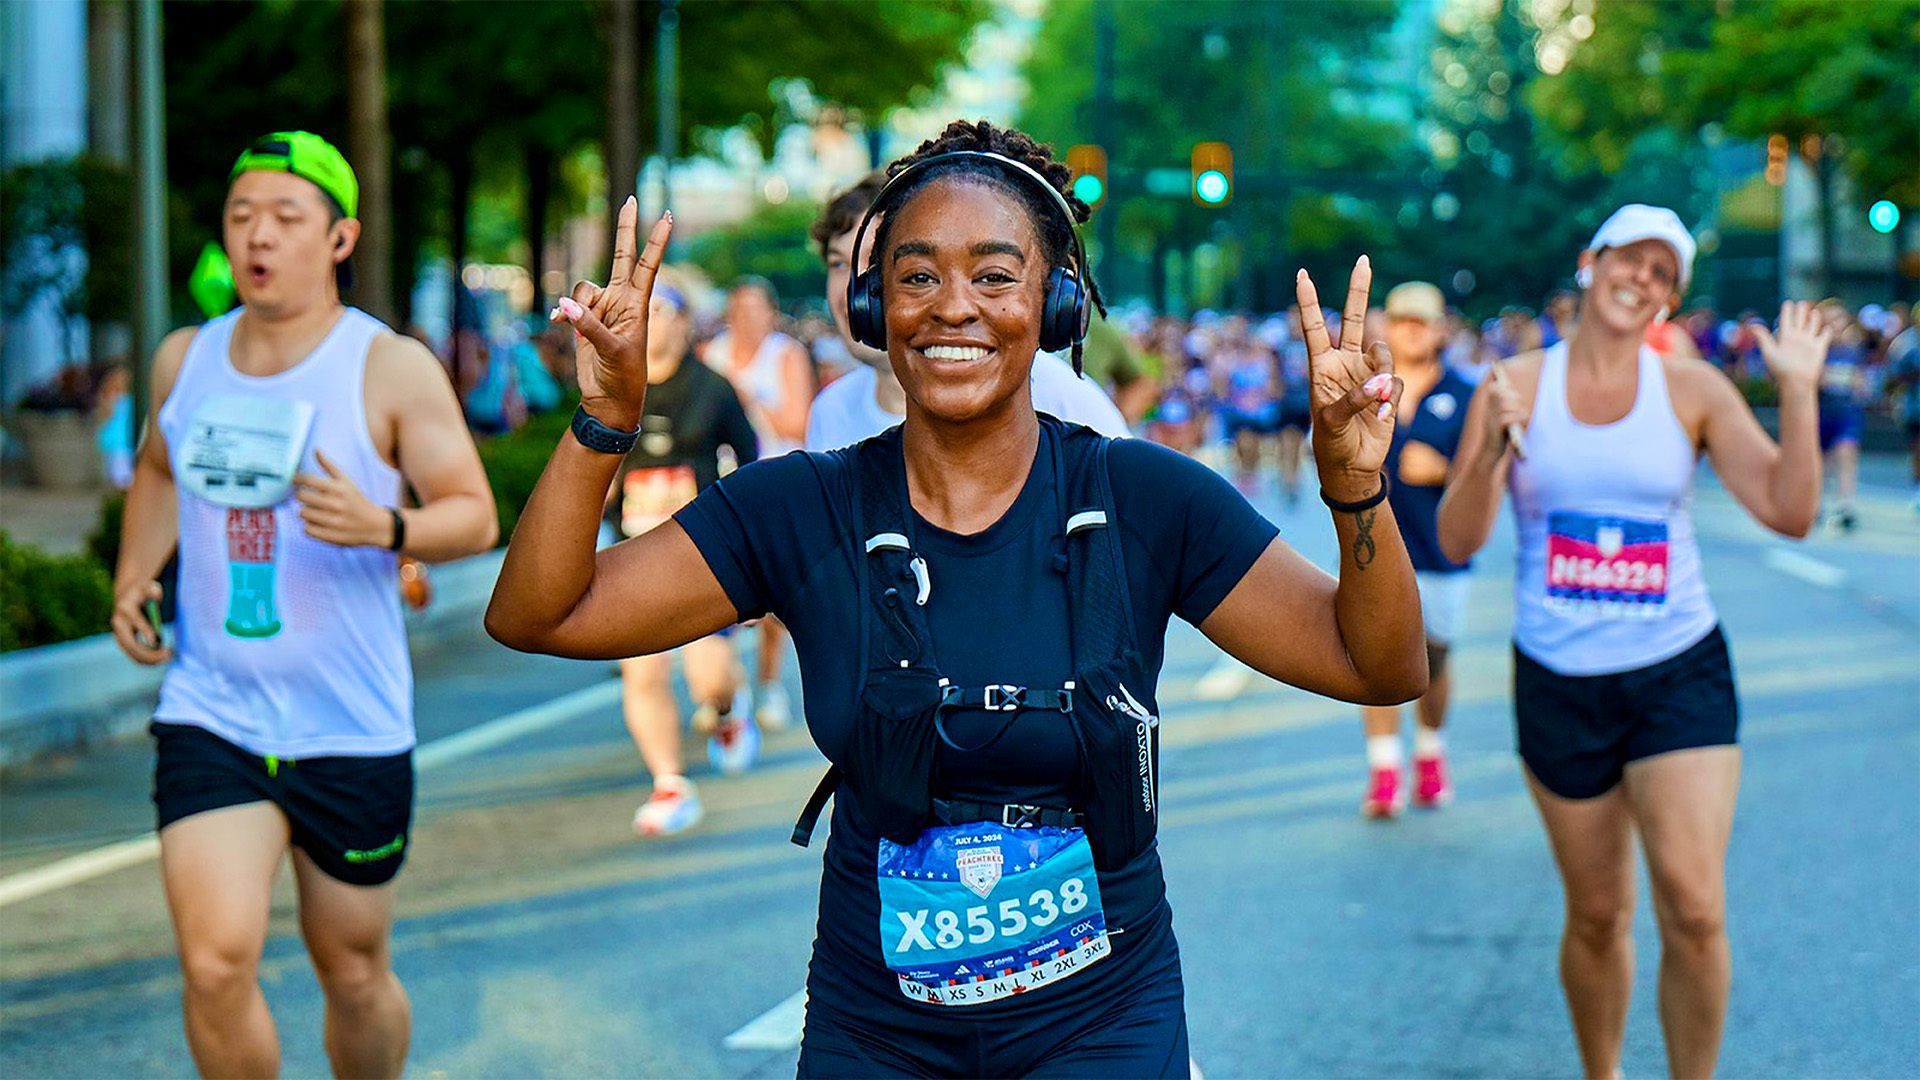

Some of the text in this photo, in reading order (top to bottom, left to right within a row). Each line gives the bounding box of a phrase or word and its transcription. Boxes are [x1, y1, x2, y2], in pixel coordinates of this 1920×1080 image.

[1136, 722, 1151, 812] outdoor INOXTO
[955, 833, 1002, 846] JULY 4, 2024
[958, 854, 1002, 865] PEACHTREE
[895, 878, 1089, 952] X85538
[1070, 920, 1094, 937] COX
[907, 984, 922, 995] W
[949, 989, 967, 1001] XS
[975, 986, 985, 997] S
[994, 982, 1007, 994] M
[1031, 970, 1047, 983] XL
[1054, 957, 1077, 974] 2XL
[1083, 941, 1105, 959] 3XL
